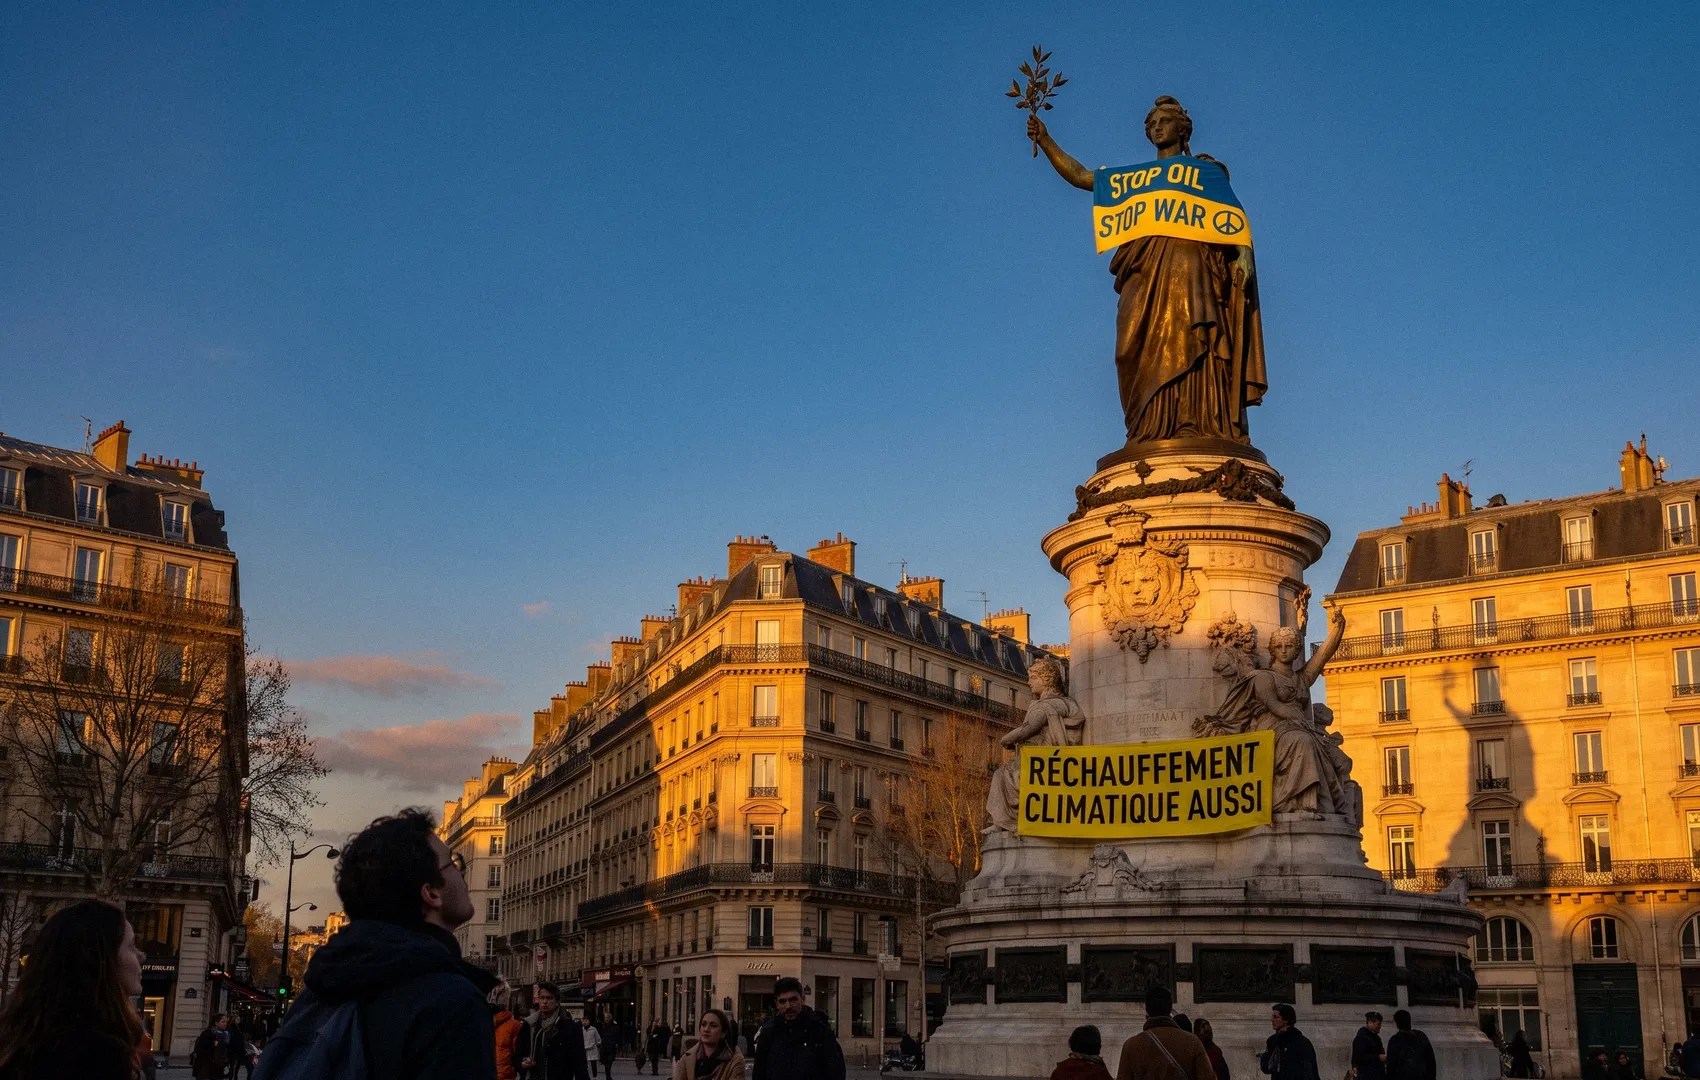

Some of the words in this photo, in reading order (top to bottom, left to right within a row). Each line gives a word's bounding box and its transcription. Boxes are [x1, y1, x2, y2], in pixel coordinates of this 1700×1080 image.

[1109, 167, 1162, 199] STOP
[1167, 163, 1204, 191] OIL
[1099, 201, 1147, 238] STOP
[1154, 198, 1207, 230] WAR
[1028, 741, 1260, 787] RÉCHAUFFEMENT
[1025, 791, 1180, 825] CLIMATIQUE
[1187, 780, 1262, 821] AUSSI
